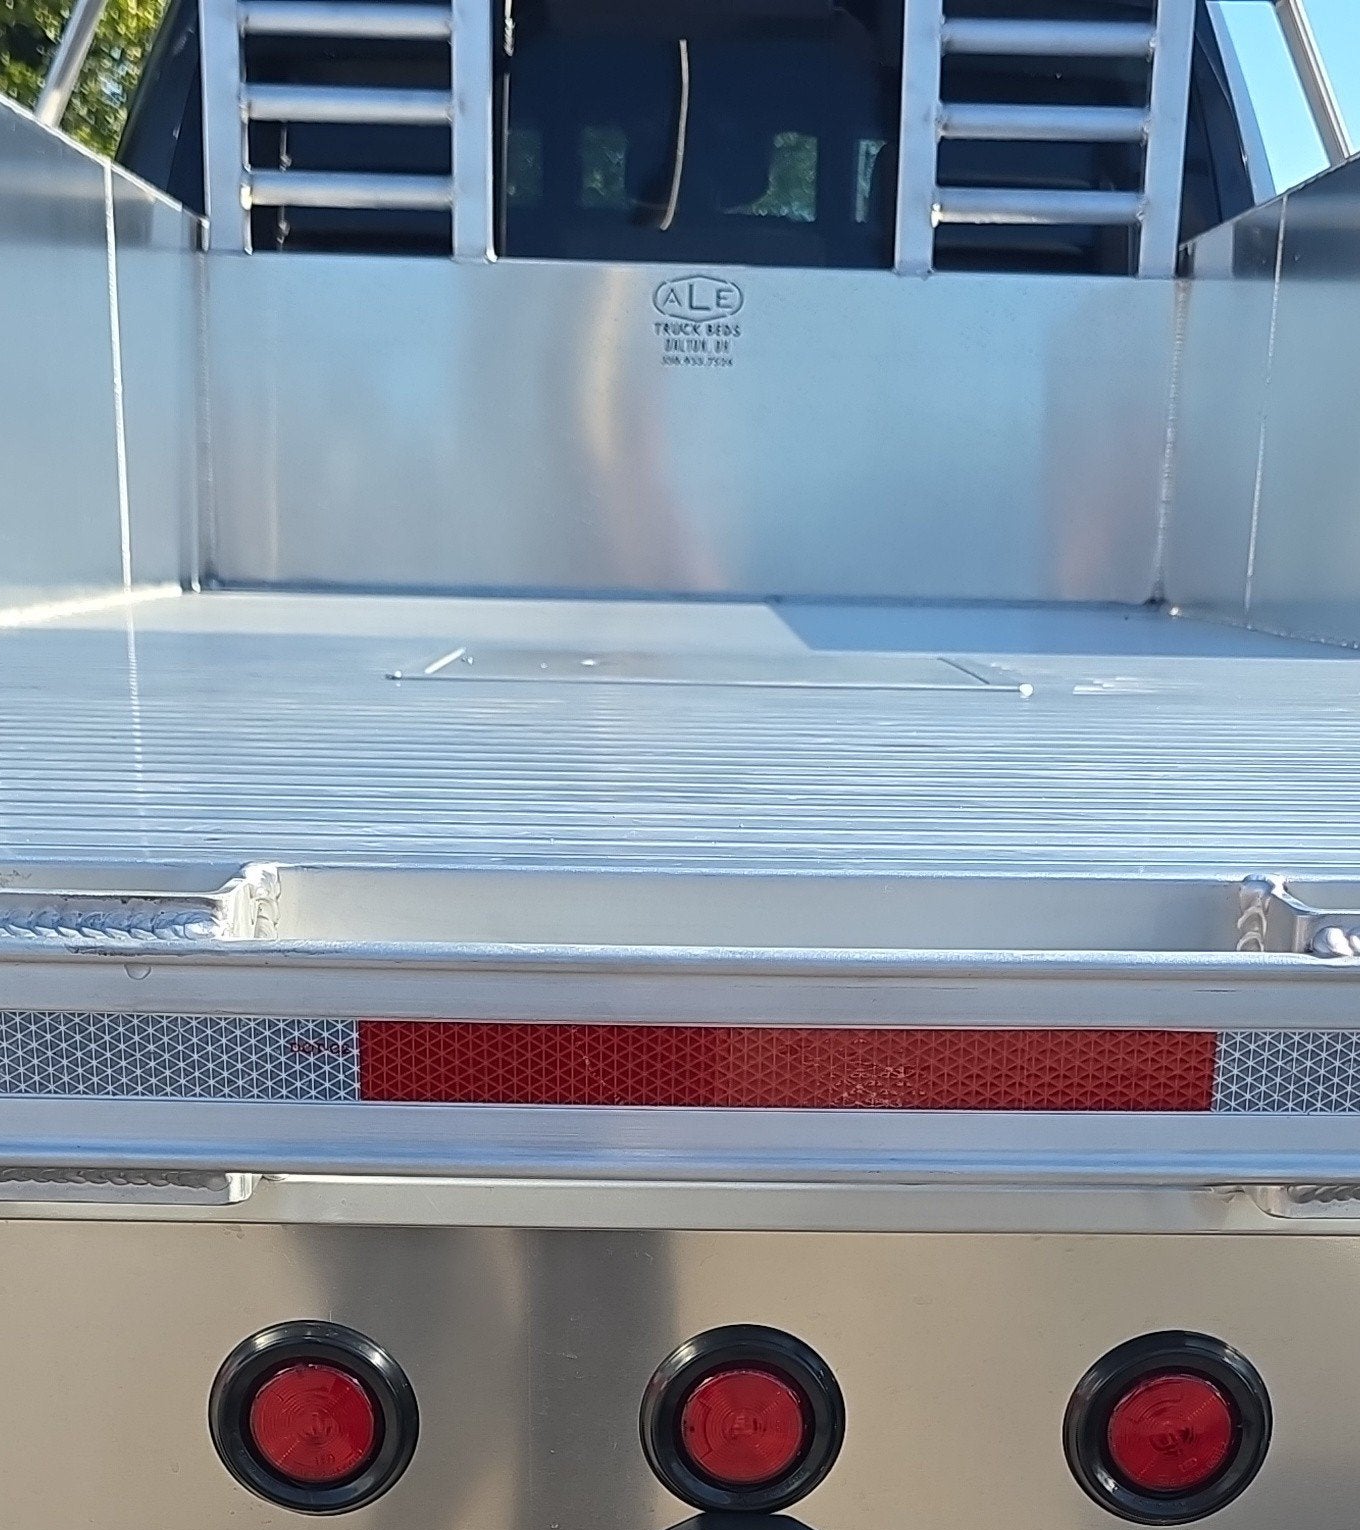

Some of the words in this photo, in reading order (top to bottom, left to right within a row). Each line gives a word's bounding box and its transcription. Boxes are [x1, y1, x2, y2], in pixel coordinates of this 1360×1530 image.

[662, 284, 734, 311] ALE
[654, 323, 701, 336] TRUCK
[290, 1042, 351, 1055] DOT-C2
